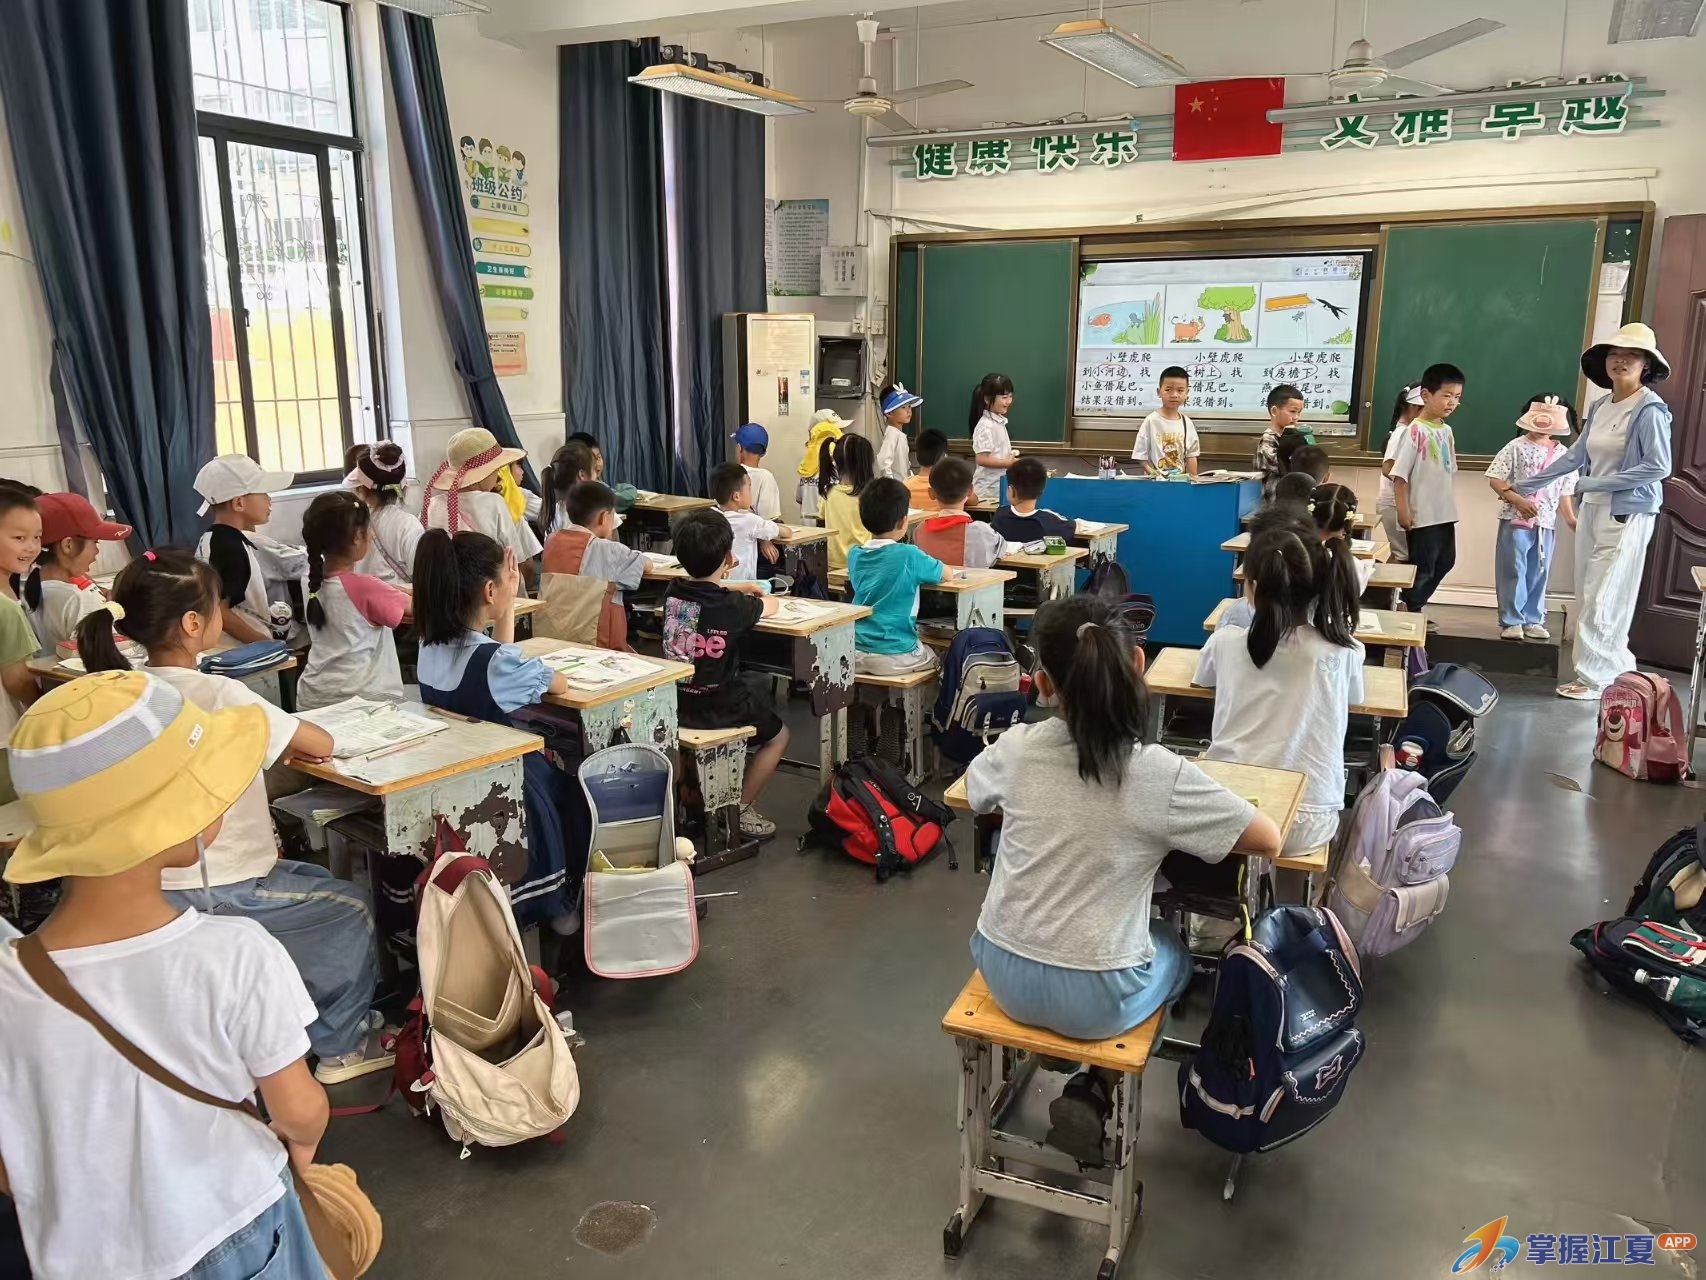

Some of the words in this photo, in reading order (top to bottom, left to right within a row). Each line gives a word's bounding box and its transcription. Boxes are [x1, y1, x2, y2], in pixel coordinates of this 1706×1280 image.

[472, 177, 523, 201] 班级公约
[1106, 352, 1151, 363] 小壁虎爬
[1195, 352, 1243, 363] 小壁虎爬
[1290, 352, 1341, 363] 小壁虎爬
[1187, 382, 1234, 393] 借尾巴。
